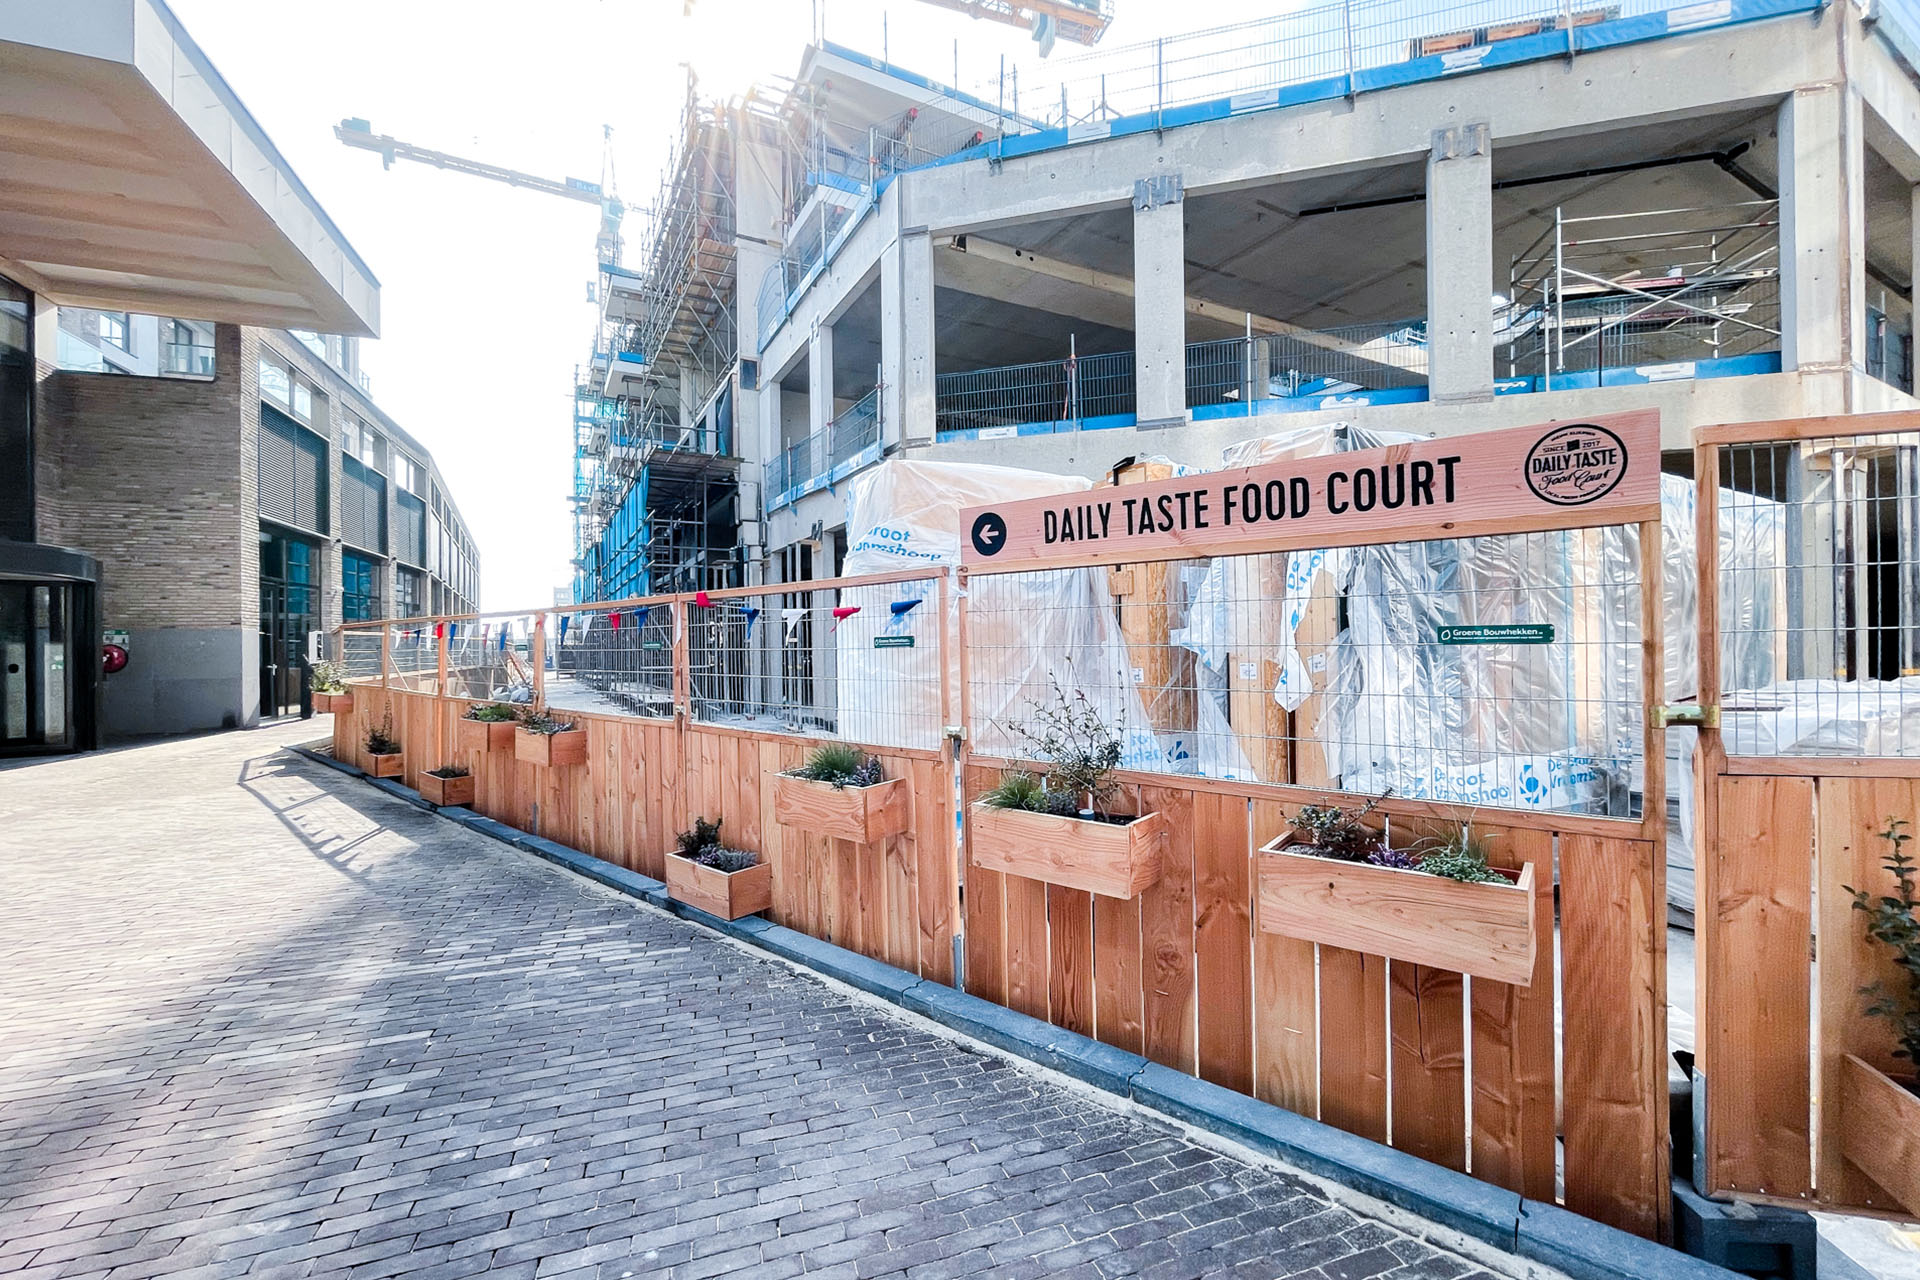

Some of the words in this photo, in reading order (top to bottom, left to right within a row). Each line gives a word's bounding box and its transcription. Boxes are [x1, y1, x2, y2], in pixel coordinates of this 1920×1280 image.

[1533, 454, 1571, 473] DAILY
[1574, 448, 1617, 468] TASTE
[1538, 471, 1575, 491] Food
[1570, 468, 1615, 491] Court
[1044, 502, 1111, 544] DAILY
[1122, 489, 1209, 536] TASTE
[1224, 477, 1311, 526] FOOD
[1327, 456, 1461, 515] COURT
[868, 526, 911, 541] root
[1483, 627, 1538, 636] Bouwhekken
